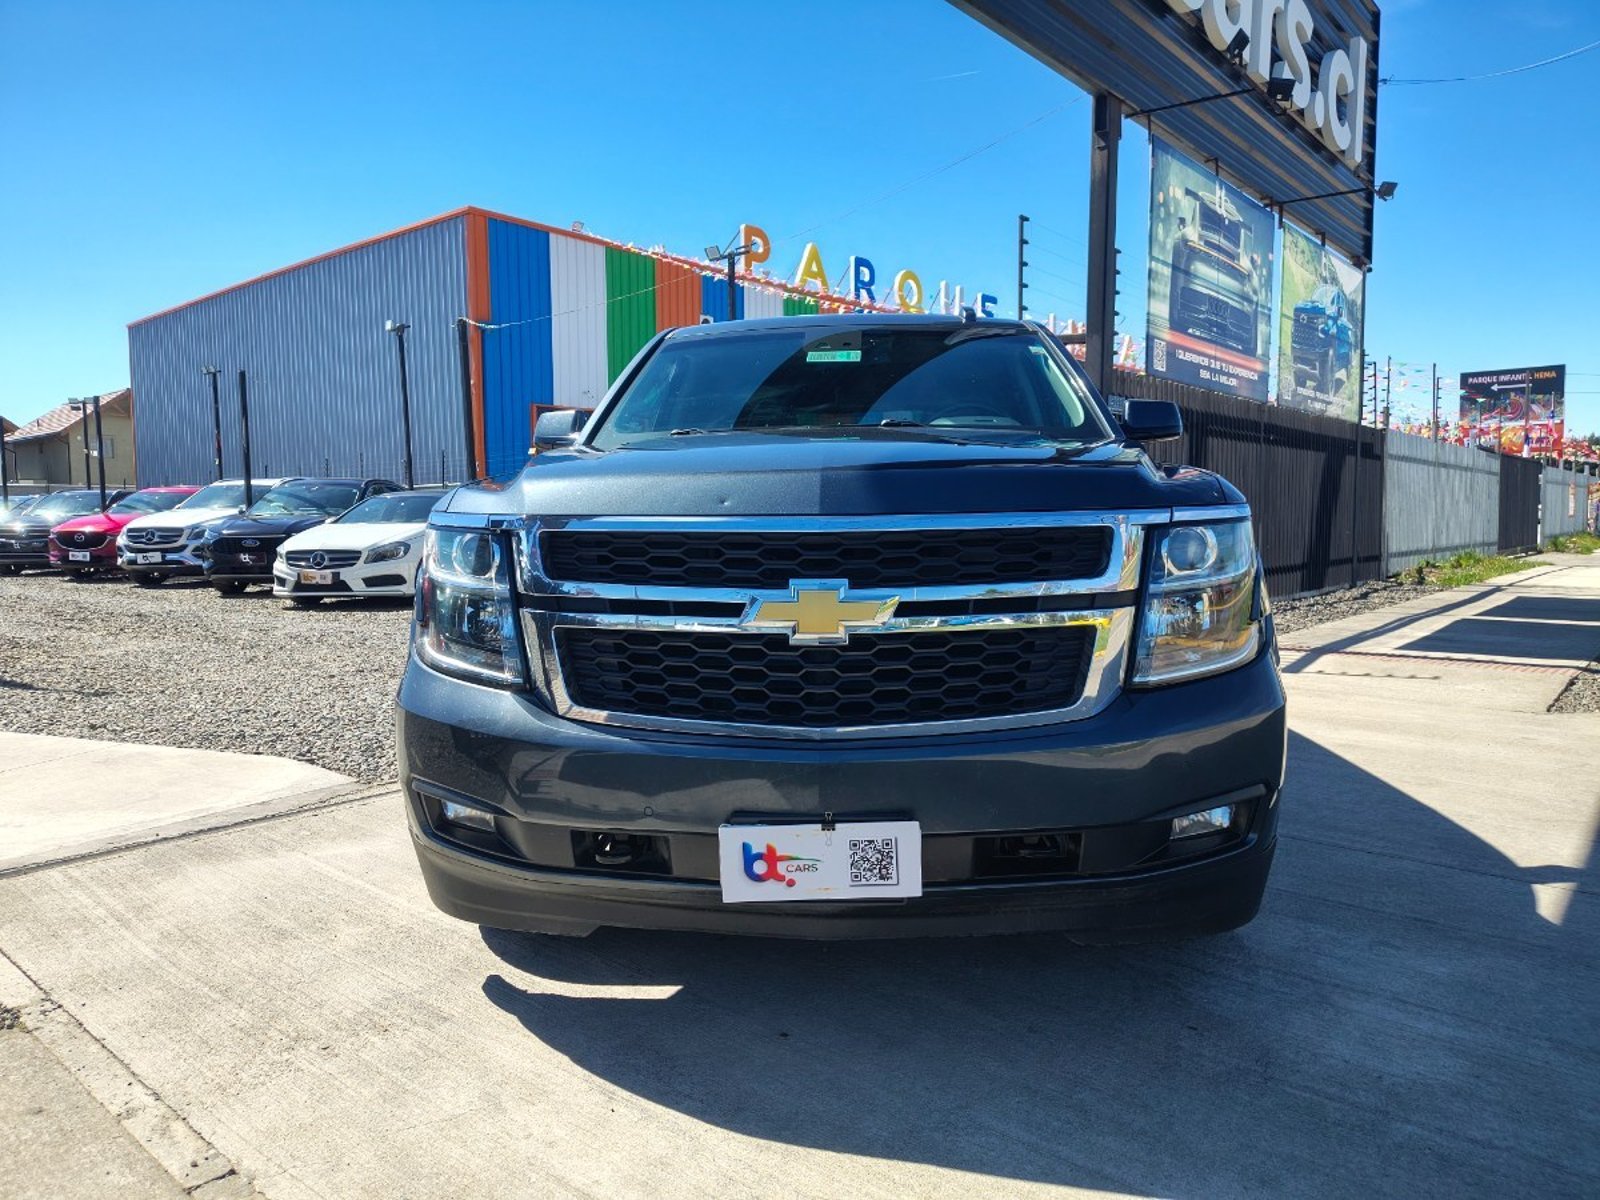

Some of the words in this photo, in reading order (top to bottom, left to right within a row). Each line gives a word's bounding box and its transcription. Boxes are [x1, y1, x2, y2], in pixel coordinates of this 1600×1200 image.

[1166, 0, 1368, 166] ars.cl
[1468, 375, 1498, 384] PARQUE
[786, 864, 819, 873] CARS
